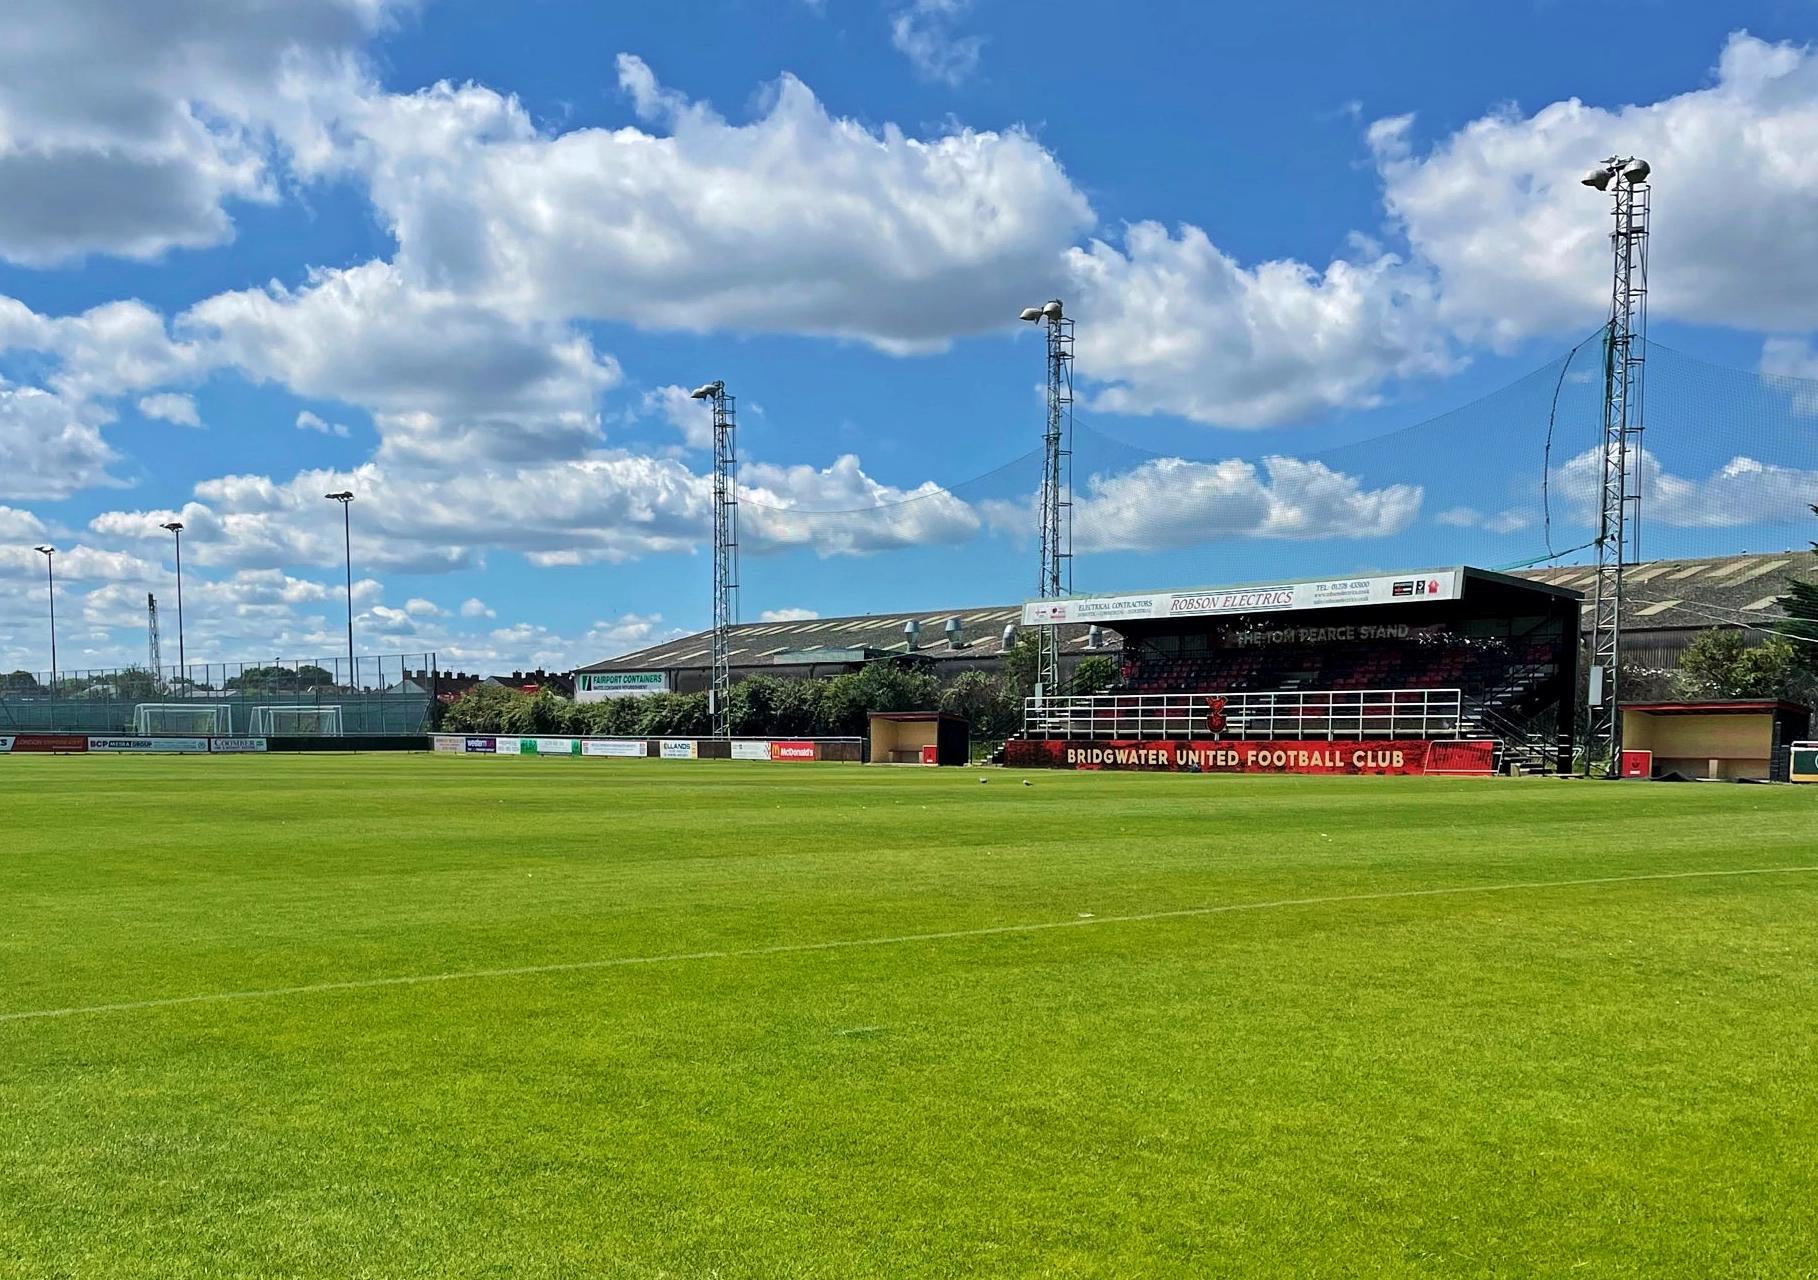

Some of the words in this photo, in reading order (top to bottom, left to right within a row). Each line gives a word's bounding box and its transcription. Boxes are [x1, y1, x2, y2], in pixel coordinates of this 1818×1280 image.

[1078, 603, 1111, 611] ELECTRICAL
[1112, 600, 1153, 609] CONTRACTORS
[1171, 597, 1219, 610] ROBSON
[1222, 591, 1294, 607] ELECTRICS
[1267, 629, 1295, 643] TOM
[1300, 626, 1355, 642] PEARCE
[1360, 624, 1409, 639] STAND
[593, 675, 622, 684] FAIRPORT
[623, 674, 662, 684] CONTAINERS
[90, 740, 108, 748] BCP
[780, 748, 814, 757] McDonald's
[1067, 749, 1168, 765] BRIDGWATER
[1176, 750, 1239, 766] UNITED
[1247, 750, 1344, 767] FOOTBALL
[1352, 750, 1404, 767] CLUB
